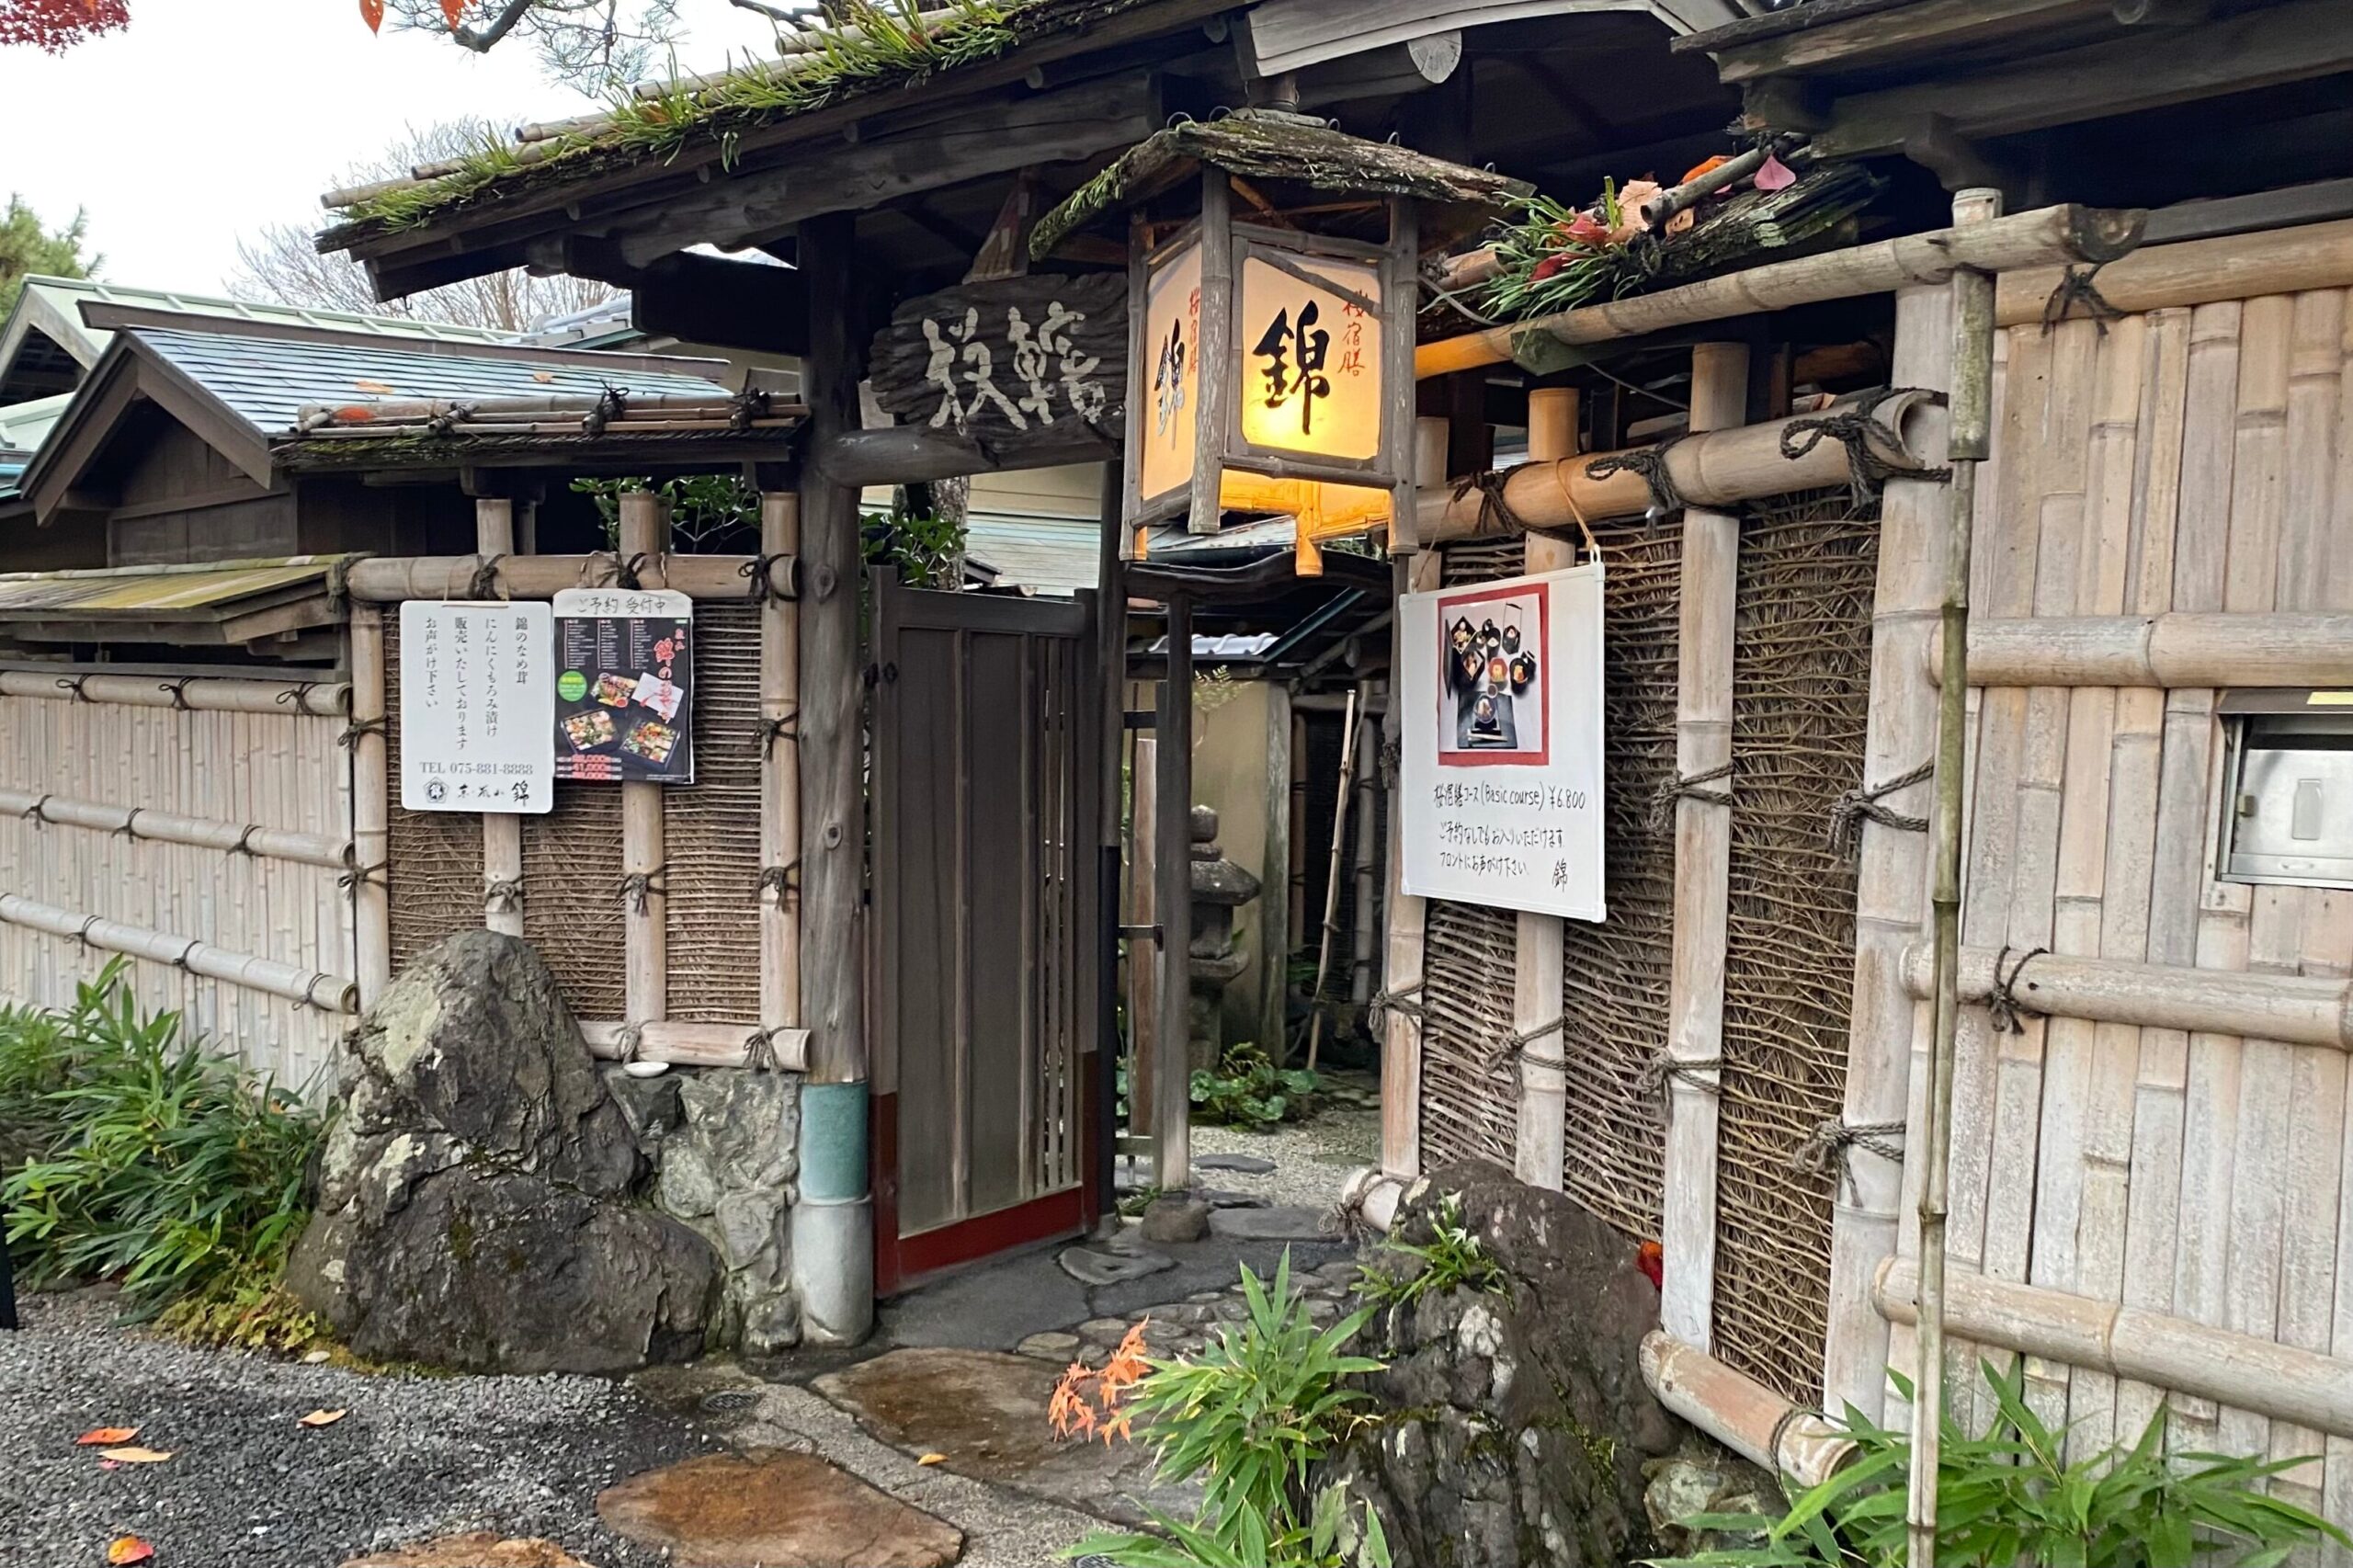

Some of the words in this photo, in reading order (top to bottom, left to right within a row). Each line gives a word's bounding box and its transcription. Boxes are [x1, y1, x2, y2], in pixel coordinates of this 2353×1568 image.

[1154, 318, 1186, 450] 錦
[1251, 300, 1331, 436] 錦
[576, 597, 619, 615] ご予約
[625, 597, 666, 615] 受付中
[425, 617, 438, 708] お声がけ下さい
[454, 616, 468, 751] 販売いたしております
[485, 618, 498, 737] にんにくもろみ漬け
[515, 616, 529, 685] 錦のなめ茸
[419, 762, 446, 774] TEL
[449, 762, 533, 775] 075-881-8888
[1481, 779, 1507, 806] (Basic
[1509, 780, 1546, 812] course)
[1552, 858, 1569, 892] 錦
